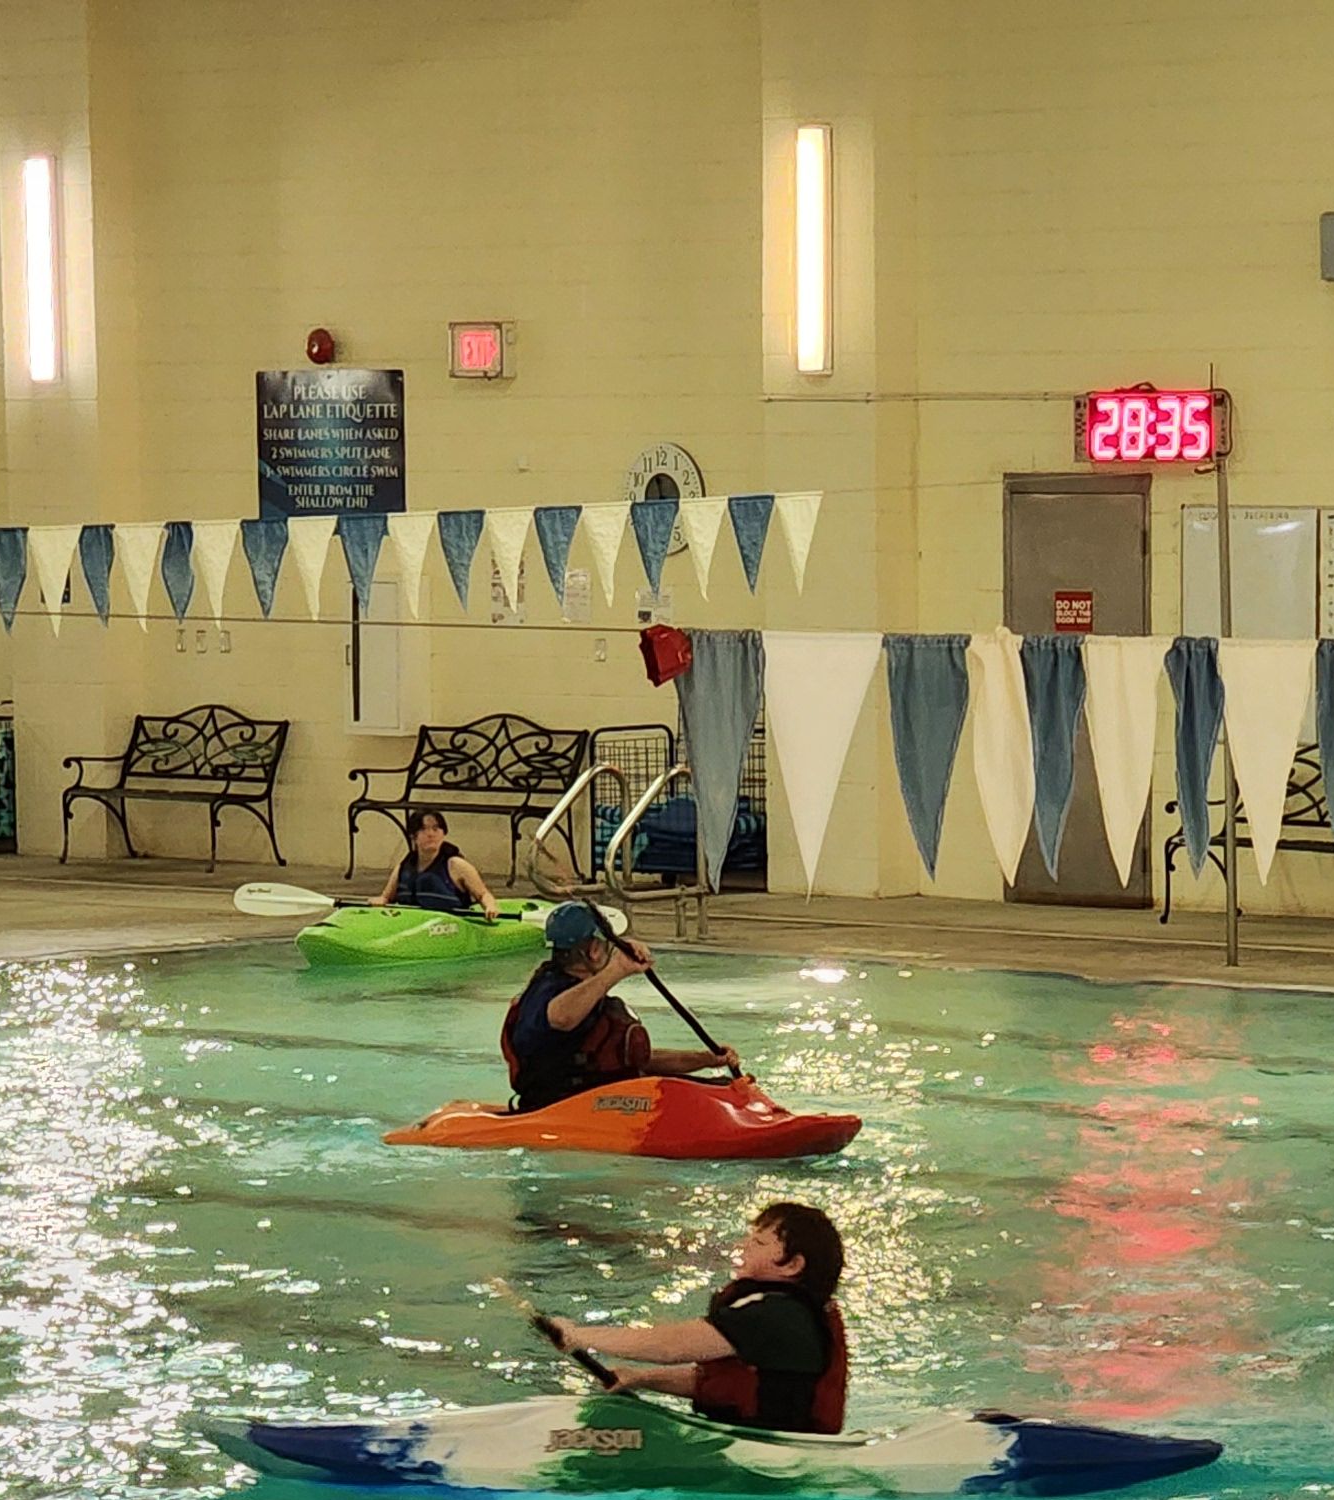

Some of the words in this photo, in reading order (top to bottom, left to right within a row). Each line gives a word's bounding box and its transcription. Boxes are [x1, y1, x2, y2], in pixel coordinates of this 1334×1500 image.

[293, 383, 339, 400] PLEASE
[341, 384, 367, 400] USE
[263, 404, 287, 419] LAP
[290, 403, 324, 419] LANE
[326, 403, 398, 423] ETIQUETTE
[263, 428, 295, 440] SHARE
[298, 427, 331, 441] LANES
[332, 428, 363, 440] WHEN
[365, 427, 399, 440] ASKED
[279, 447, 332, 459] SWIMMERS
[335, 446, 362, 460] SPLIT
[364, 447, 392, 459] LANE
[655, 450, 668, 467] 12
[277, 465, 332, 478] SWIMMERS
[332, 465, 369, 478] CIRCLE
[370, 465, 399, 478] SWIM
[643, 457, 653, 473] 11
[287, 484, 322, 496] ENTER
[323, 484, 353, 496] FROM
[354, 484, 375, 496] THE
[295, 497, 344, 509] SHALLOW
[346, 497, 368, 509] END
[1056, 600, 1070, 609] DO
[1072, 600, 1091, 609] NOT
